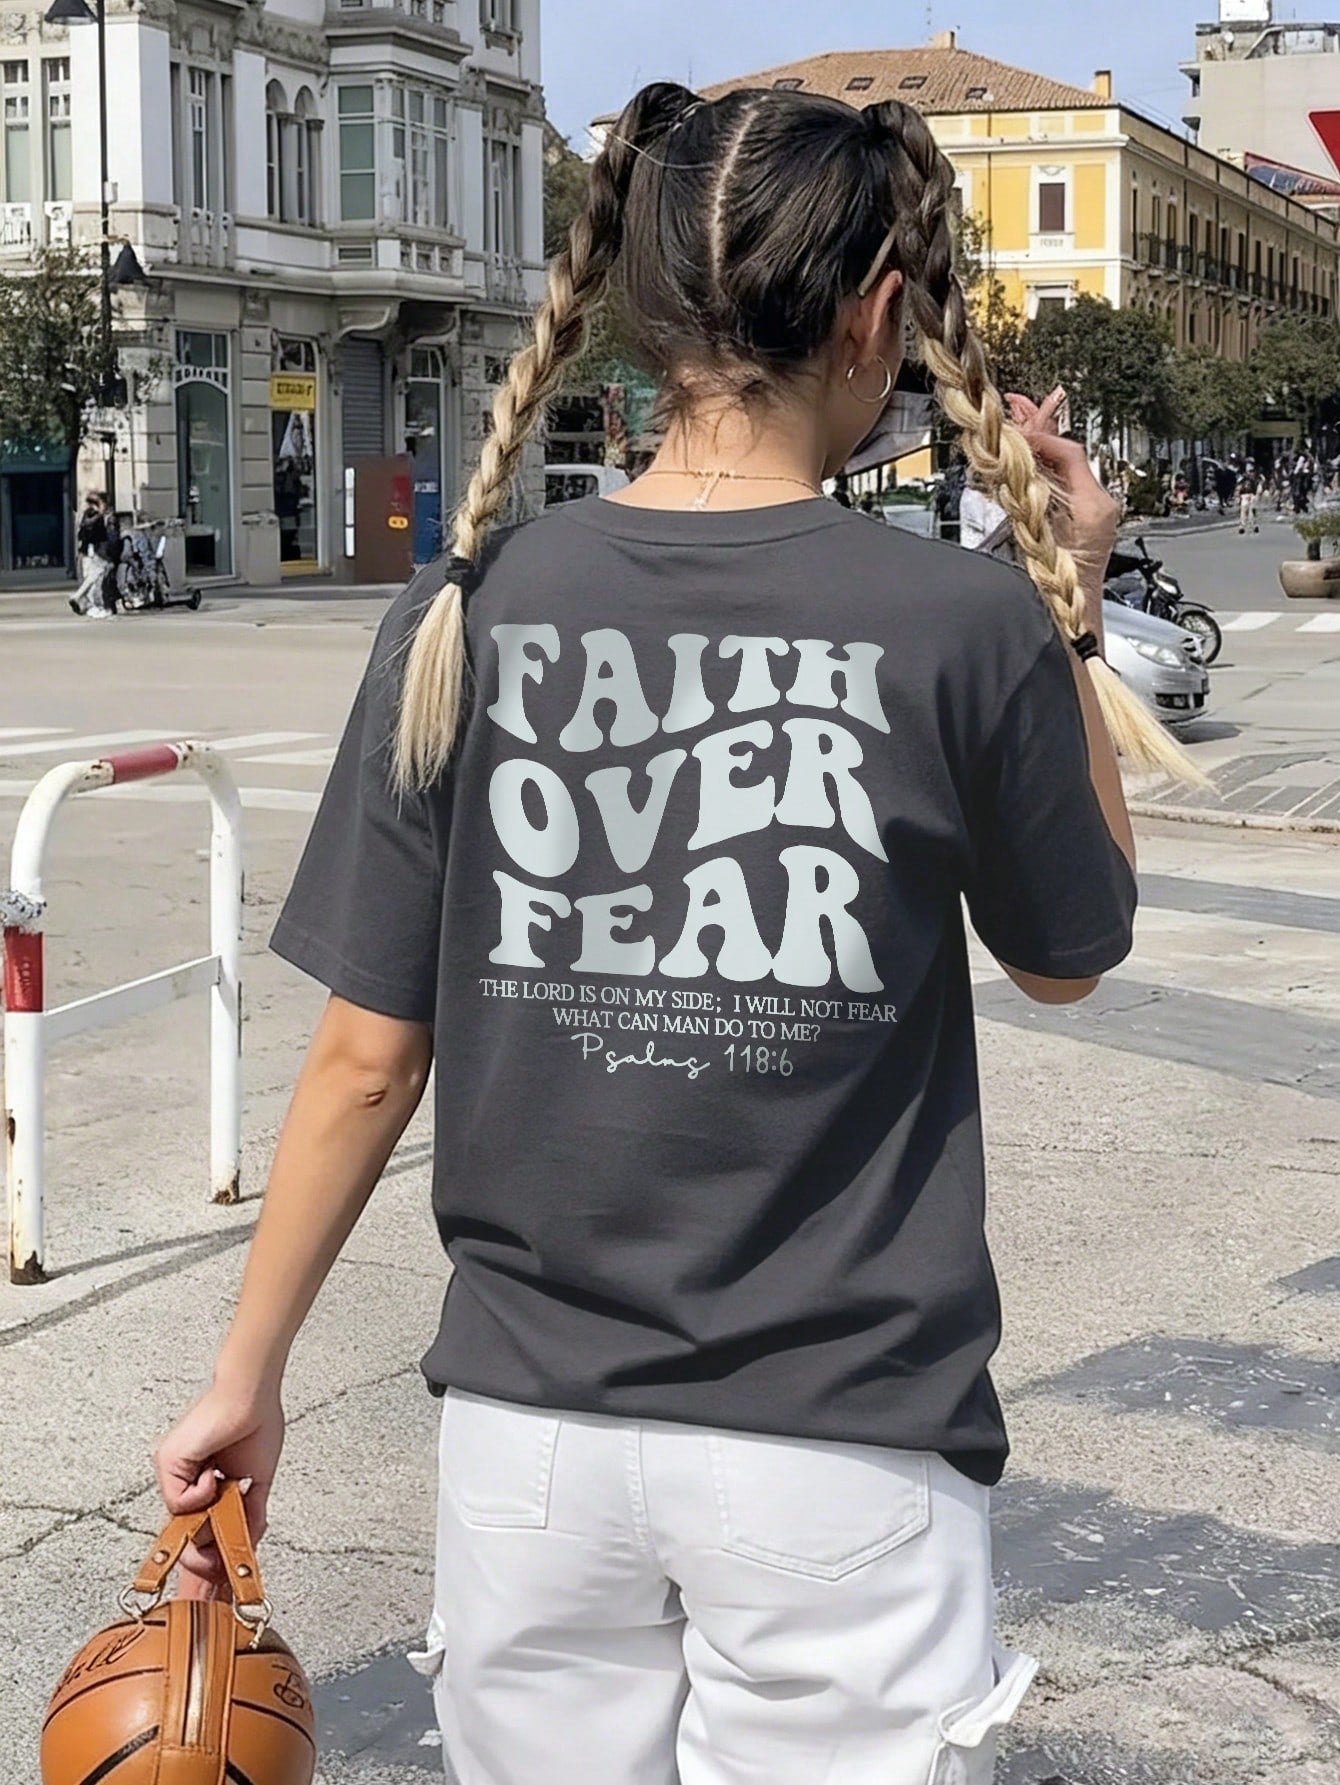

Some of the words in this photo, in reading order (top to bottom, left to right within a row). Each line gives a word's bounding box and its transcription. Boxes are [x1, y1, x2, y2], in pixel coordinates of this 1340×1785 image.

[487, 623, 892, 752] FAITH
[488, 717, 890, 878] OVER
[488, 844, 885, 994] FEAR
[478, 978, 518, 999] THE
[522, 981, 575, 1002] LORD
[578, 984, 597, 1004] IS
[600, 986, 631, 1006] ON
[634, 988, 668, 1009] MY
[671, 990, 722, 1015] SIDE;
[733, 994, 742, 1014] I
[744, 995, 796, 1016] WILL
[800, 999, 844, 1019] NOT
[847, 1002, 898, 1023] FEAR
[552, 1007, 614, 1029] WHAT
[617, 1011, 659, 1032] CAN
[661, 1014, 710, 1036] MAN
[714, 1017, 744, 1038] DO
[747, 1020, 776, 1040] TO
[780, 1022, 821, 1042] ME?
[570, 1031, 711, 1080] Psalms
[723, 1043, 794, 1077] 118:6
